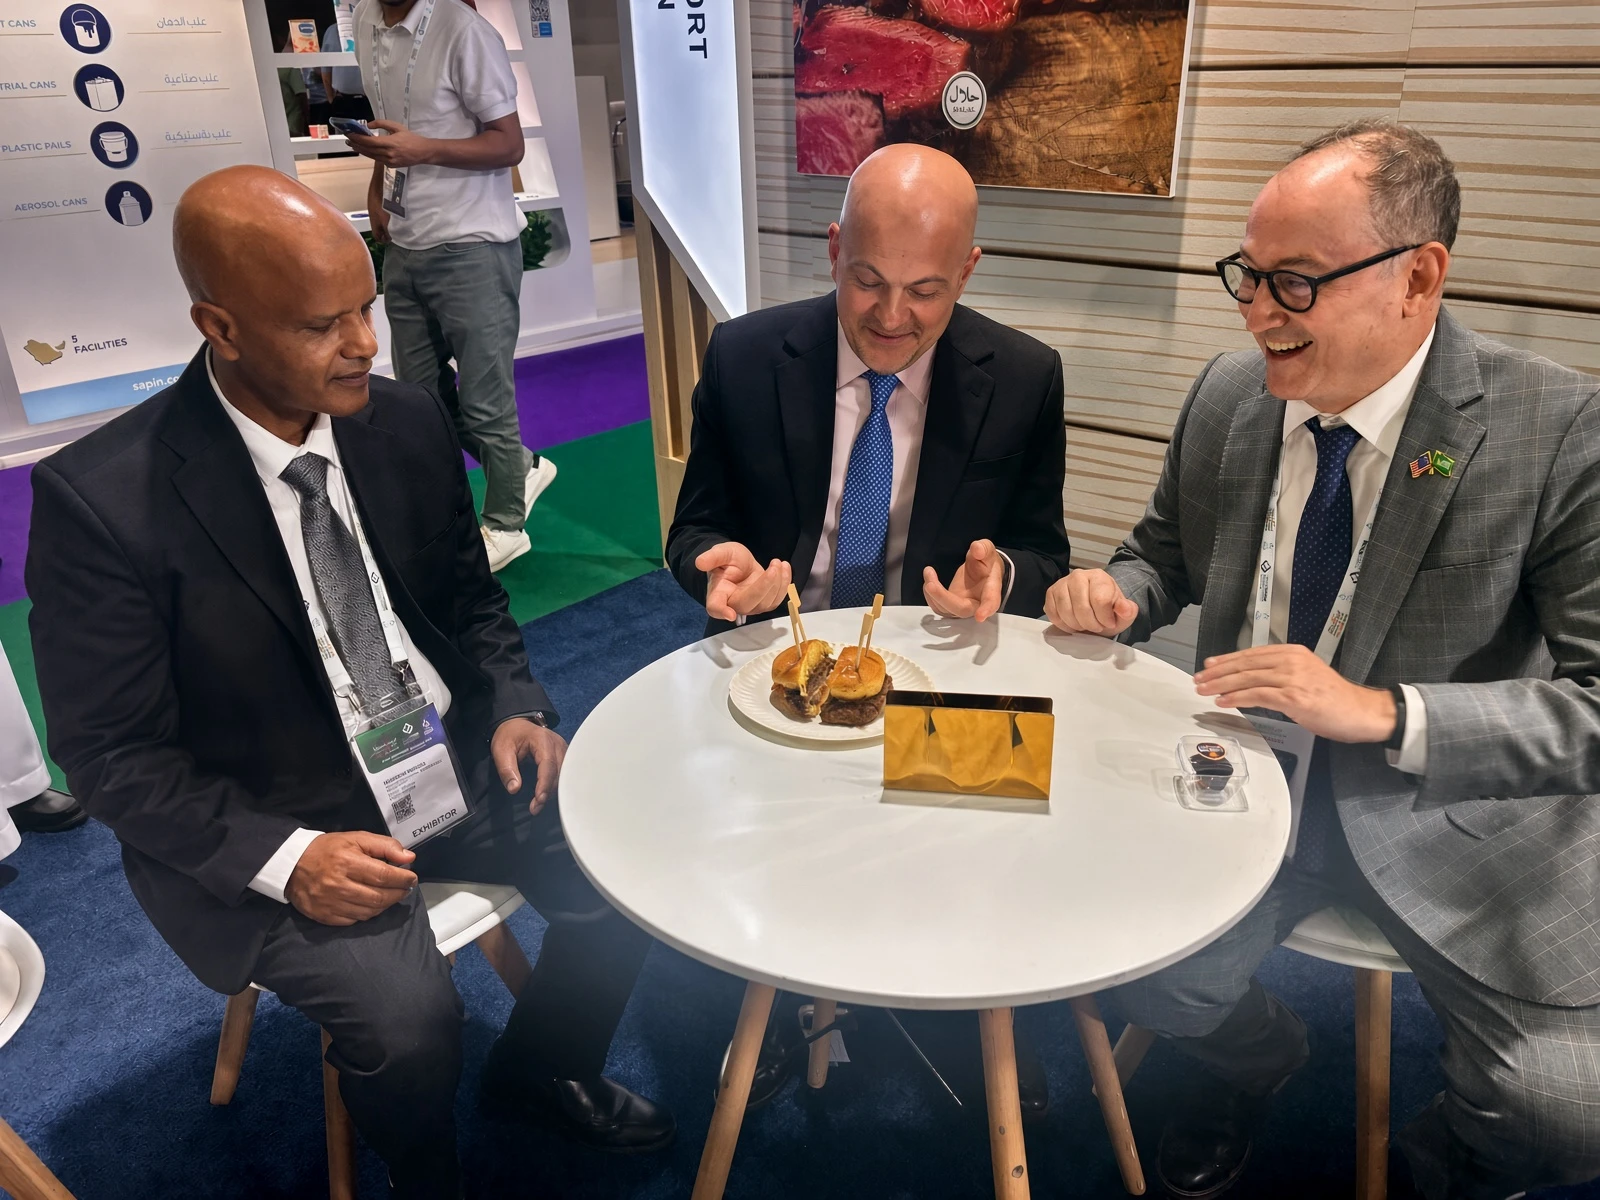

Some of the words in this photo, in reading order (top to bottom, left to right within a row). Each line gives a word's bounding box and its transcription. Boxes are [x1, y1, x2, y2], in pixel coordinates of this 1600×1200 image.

[8, 20, 37, 28] CANS
[186, 17, 207, 28] علب
[29, 80, 57, 89] CANS
[198, 73, 219, 85] علب
[949, 84, 980, 103] حلال
[211, 129, 232, 140] علب
[1, 143, 43, 152] PLASTIC
[44, 140, 72, 150] PAILS
[14, 200, 61, 212] AEROSOL
[61, 197, 88, 207] CANS
[71, 334, 78, 343] 5
[74, 337, 128, 354] FACILITIES
[132, 375, 180, 391] sapin.co
[412, 808, 458, 838] EXHIBITOR
